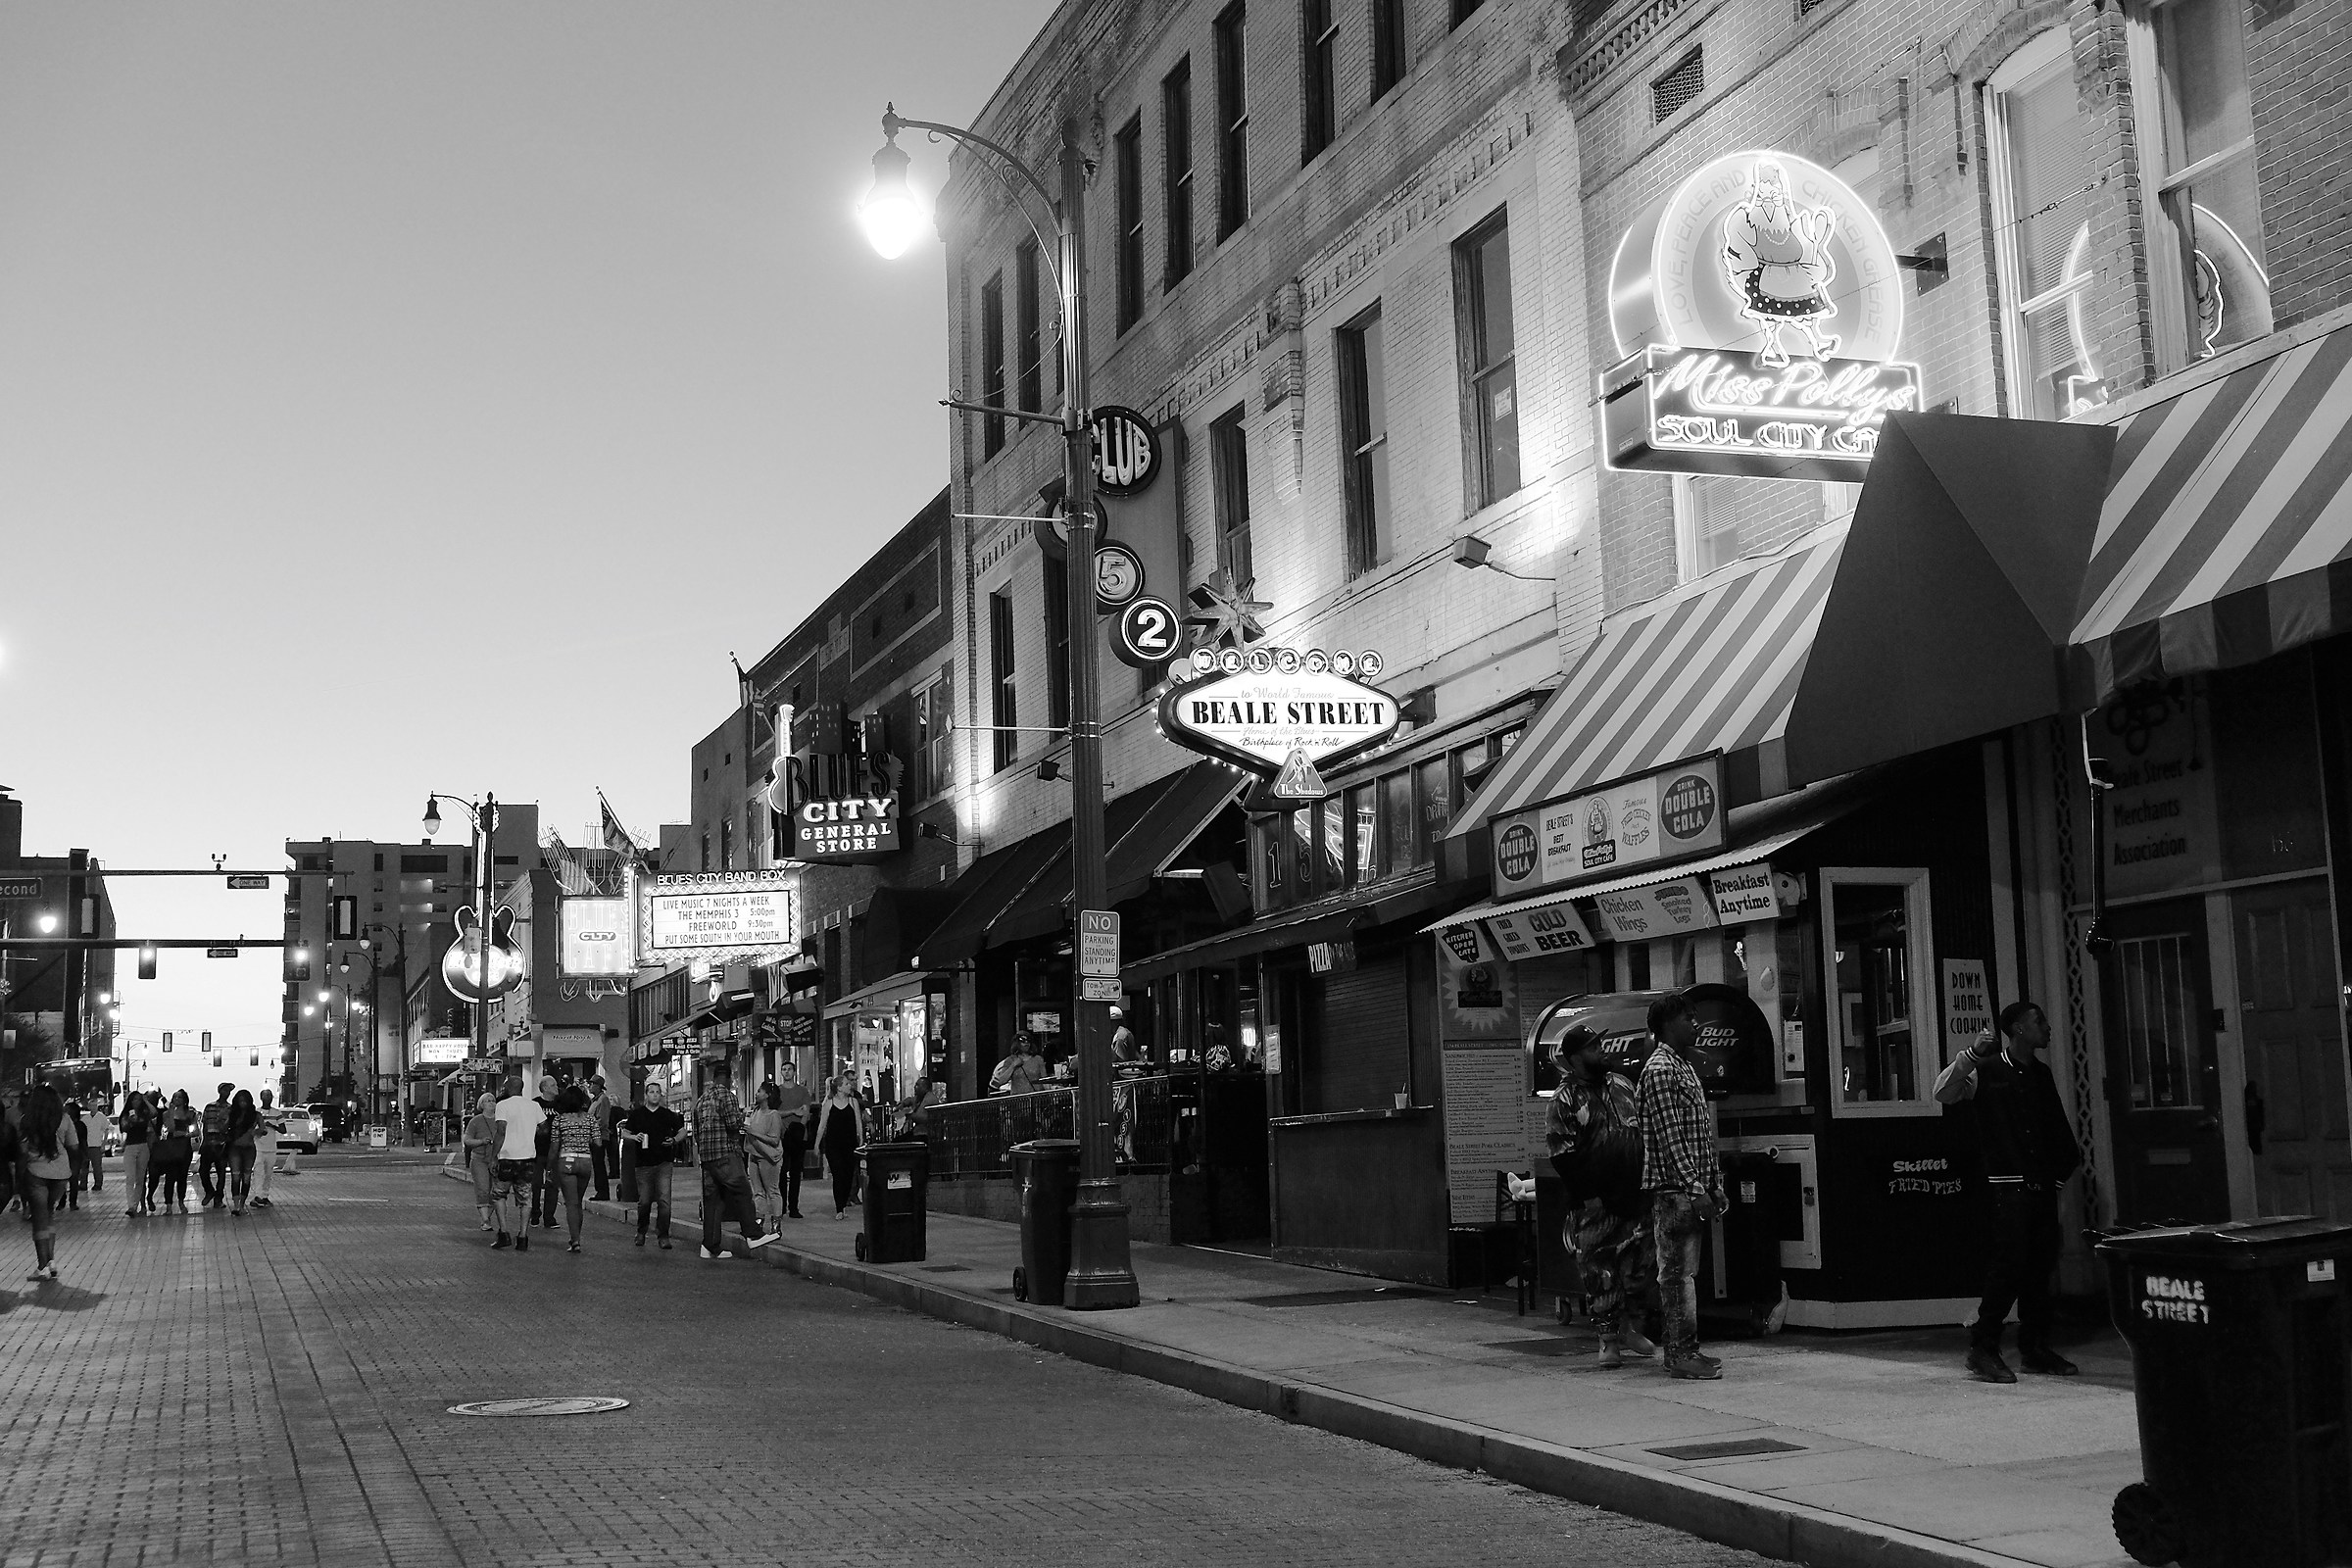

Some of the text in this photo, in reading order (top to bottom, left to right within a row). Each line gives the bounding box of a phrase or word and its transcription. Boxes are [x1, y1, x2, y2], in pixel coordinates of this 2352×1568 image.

[1672, 197, 1709, 256] PEACE
[1709, 169, 1747, 196] AND
[1801, 179, 1884, 340] CHICKEN GREASE
[1652, 354, 1773, 407] Miss
[1656, 414, 1754, 448] SOUL
[1756, 421, 1828, 451] CITY
[1098, 556, 1126, 595] 5
[1137, 609, 1167, 648] 2
[1196, 651, 1378, 675] WELCOME
[1241, 686, 1335, 699] to World Famous
[1192, 701, 1385, 725] BEALE STREET
[1243, 726, 1317, 737] Home of the Blues
[1239, 736, 1284, 750] Birthplace
[1285, 739, 1293, 750] of
[1294, 736, 1314, 747] Rock
[1321, 737, 1346, 747] Roll
[2143, 760, 2182, 784] Street
[786, 752, 891, 816] BLUES
[1280, 783, 1324, 796] The Shadows
[1676, 780, 1695, 792] DRINK
[1666, 786, 1711, 814] DOUBLE
[803, 799, 893, 823] CITY
[2113, 799, 2180, 828] Merchants
[1673, 810, 1705, 833] COLA
[801, 822, 892, 841] GENERAL
[1509, 828, 1525, 838] DRINK
[1553, 834, 1564, 845] BEST
[1622, 826, 1650, 846] WAFFLES
[816, 837, 877, 854] STORE
[1500, 836, 1535, 859] DOUBLE
[2114, 834, 2186, 865] Association
[1506, 859, 1531, 876] COLA
[657, 869, 785, 885] BLUES CITY BAND BOX
[1712, 872, 1771, 895] Breakfast
[0, 884, 37, 896] econd
[1654, 885, 1689, 901] JUMBO
[662, 896, 770, 910] LIVE MUSIC 7 NIGHTS A WEEK
[1600, 897, 1643, 915] Chicken
[1661, 897, 1691, 909] Smoked
[1667, 906, 1691, 916] Turkey
[1719, 895, 1771, 915] Anytime
[678, 907, 775, 920] THE MEMPHIS 3 5:00pm
[1528, 908, 1567, 934] COLD
[1673, 915, 1691, 924] Legs
[689, 920, 773, 932] FREEWORLD 9:30pm
[1088, 914, 1111, 931] NO
[1496, 918, 1513, 930] FRIED
[1613, 914, 1649, 933] Wings
[664, 931, 780, 945] PUT SOME SOUTH IN YOUR MOUTH
[1084, 935, 1114, 946] PARKING
[1446, 931, 1474, 944] KITCHEN
[1453, 940, 1474, 950] OPEN
[1534, 930, 1586, 953] BEER
[1084, 947, 1116, 956] STANDING
[1307, 941, 1332, 973] PIZZA
[1458, 947, 1476, 956] LATE
[1084, 956, 1115, 965] ANYTIME
[1951, 971, 1982, 990] DOWN
[1952, 994, 1984, 1011] HOME
[779, 1019, 793, 1028] STOP
[1700, 1027, 1737, 1039] BUD
[1694, 1037, 1740, 1049] LIGHT
[1892, 1157, 1948, 1173] Skillet
[1888, 1177, 1963, 1195] FRIED PIES
[2141, 1299, 2210, 1324] STREET
